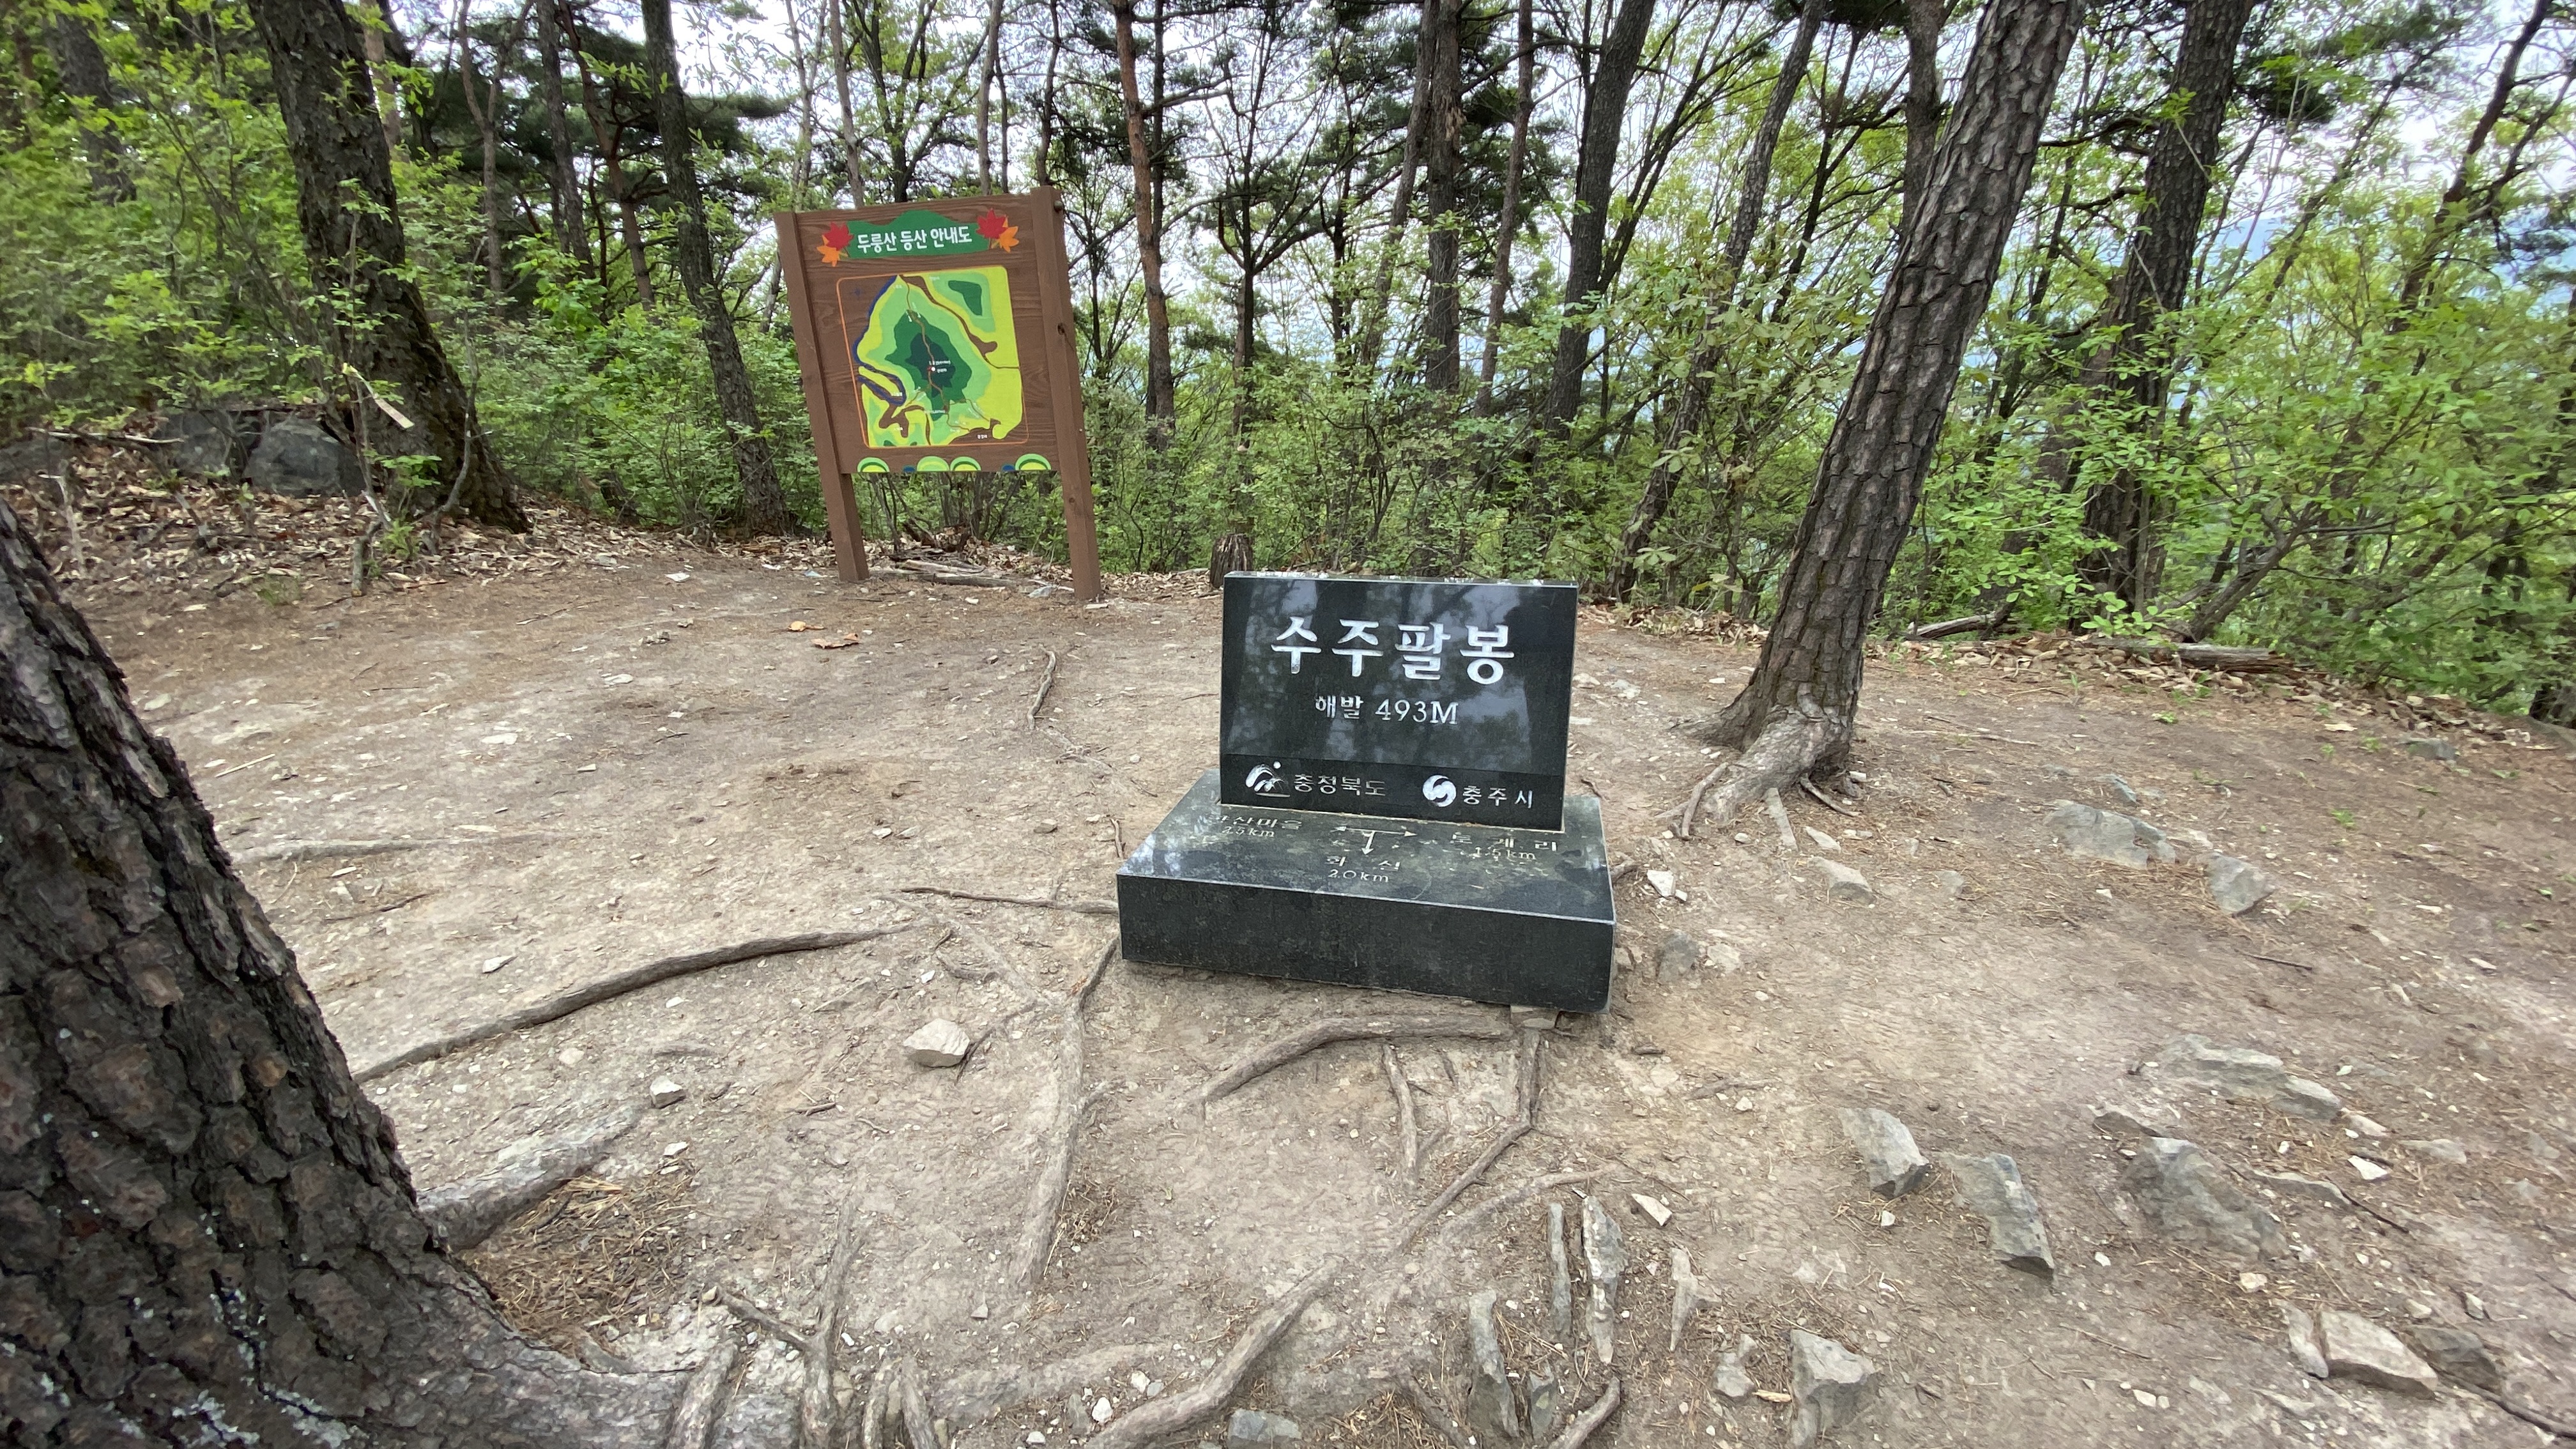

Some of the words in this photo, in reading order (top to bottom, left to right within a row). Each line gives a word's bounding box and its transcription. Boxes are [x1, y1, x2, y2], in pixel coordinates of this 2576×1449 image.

[857, 231, 897, 254] 두룽산
[900, 229, 927, 251] 등산
[930, 226, 972, 248] 안내도
[1271, 616, 1515, 685] 수주팔봉
[1315, 694, 1363, 720] 해발
[1375, 698, 1459, 724] 493M
[1293, 774, 1386, 797] 충청북도
[1462, 785, 1533, 809] 충주시
